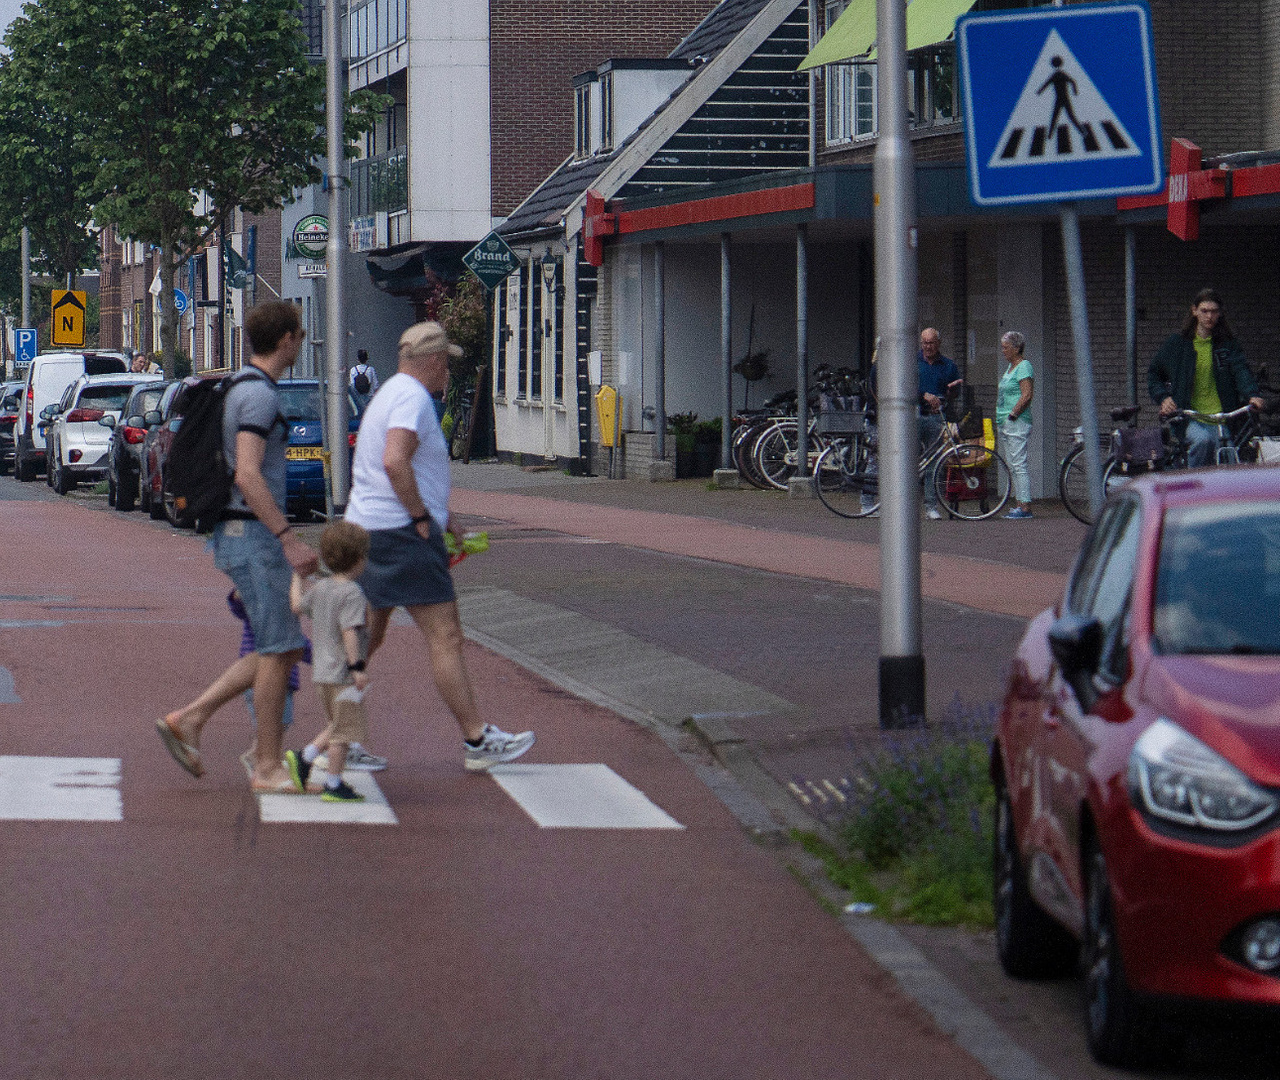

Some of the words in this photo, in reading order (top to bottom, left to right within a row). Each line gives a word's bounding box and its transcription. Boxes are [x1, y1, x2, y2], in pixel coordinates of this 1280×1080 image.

[298, 233, 329, 241] Heineke
[474, 248, 511, 262] Brand
[62, 316, 74, 332] N
[20, 331, 32, 348] P
